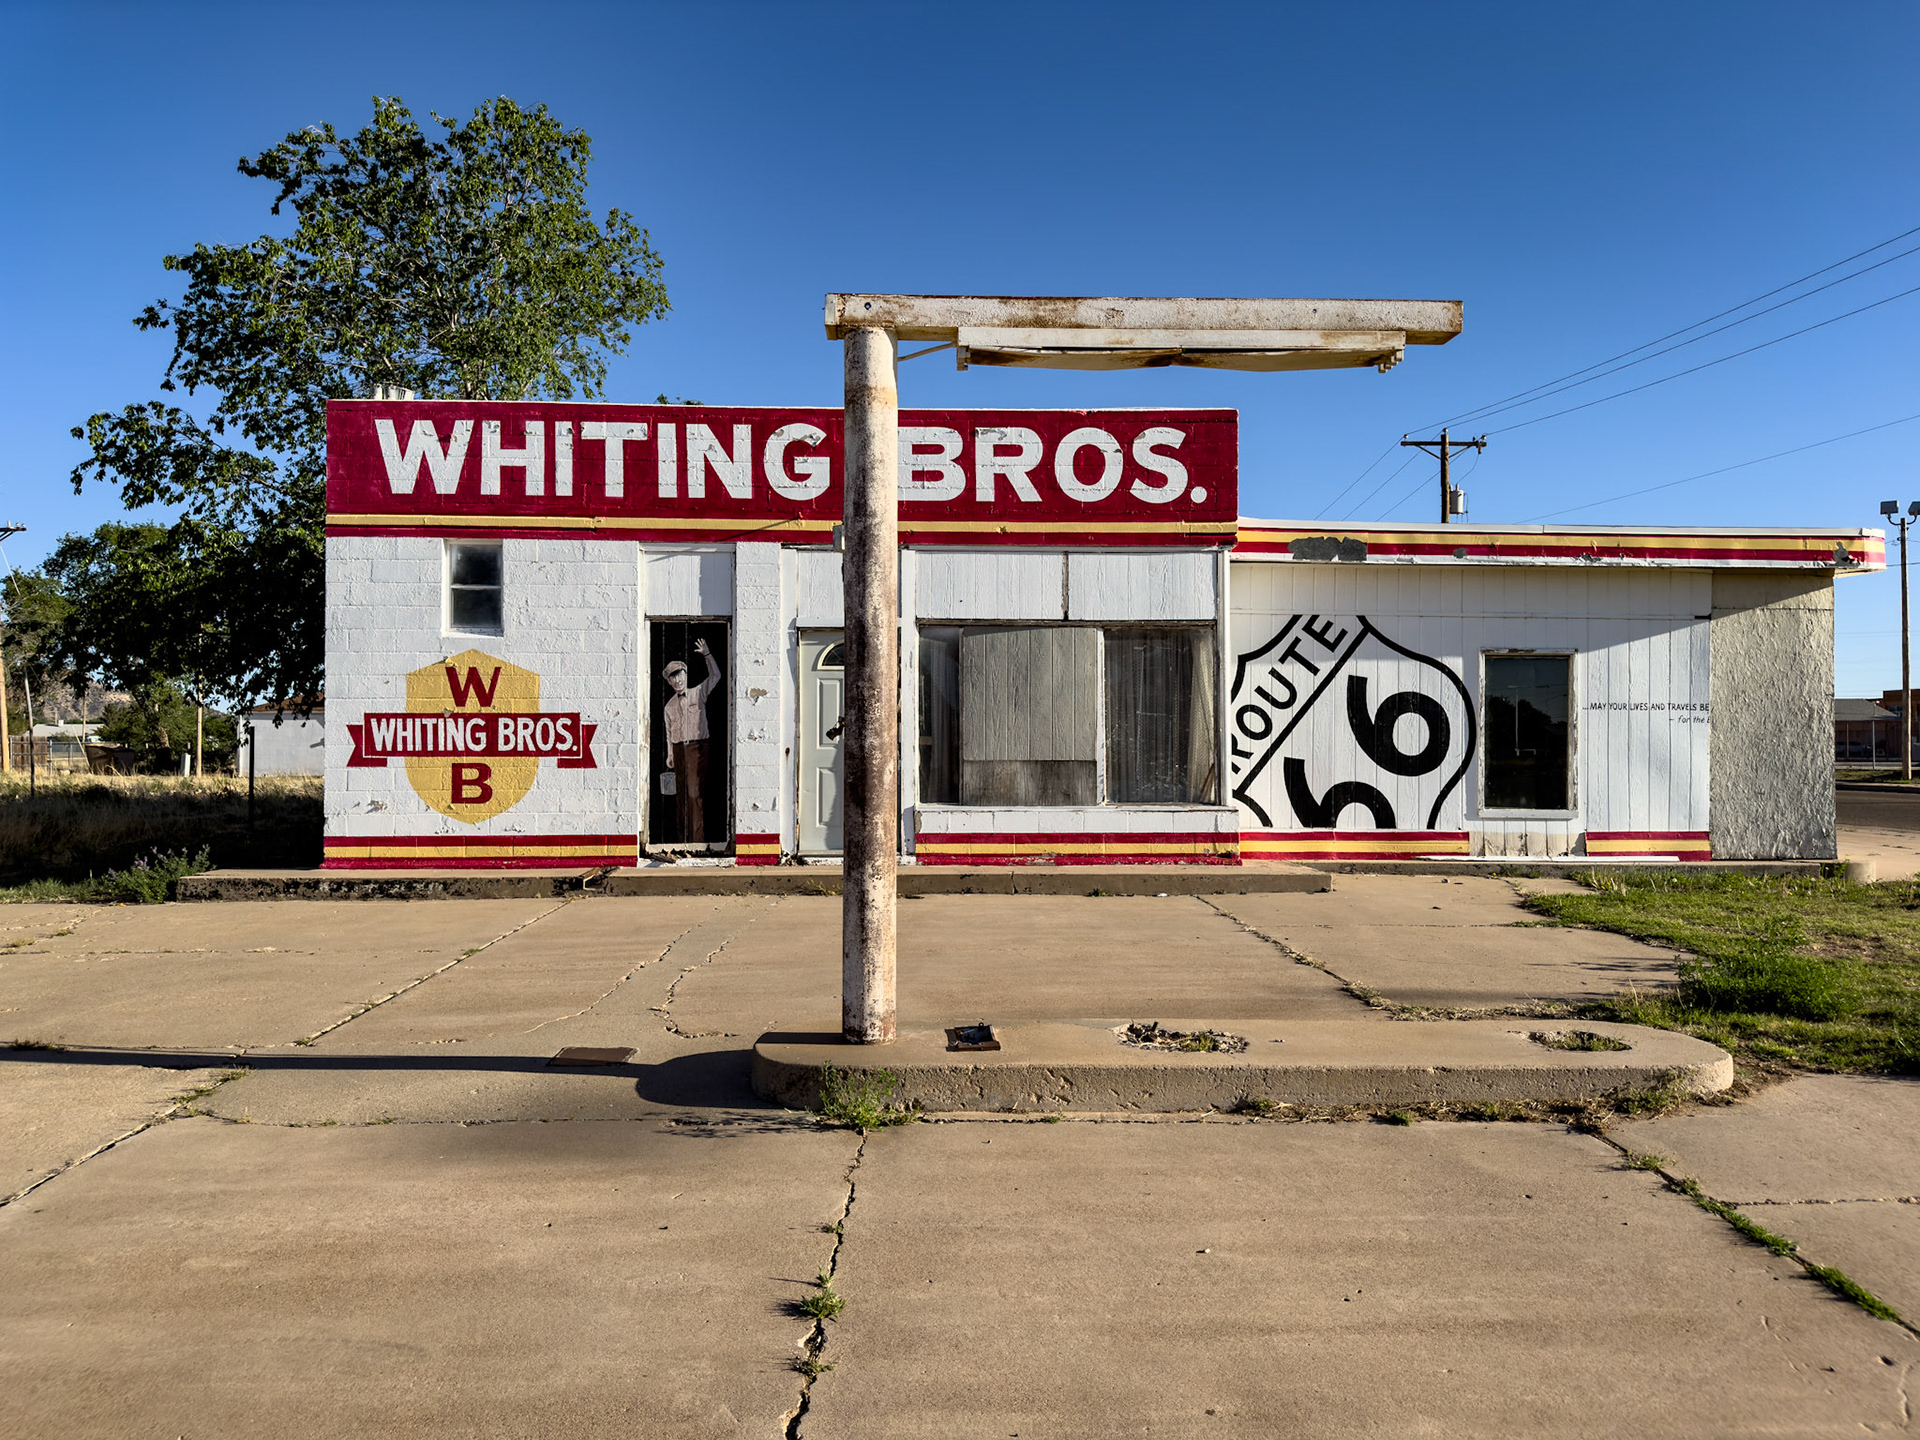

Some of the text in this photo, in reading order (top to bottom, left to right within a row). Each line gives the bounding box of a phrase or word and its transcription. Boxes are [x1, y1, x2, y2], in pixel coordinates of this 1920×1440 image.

[375, 419, 1208, 505] WHITING BROS.
[445, 667, 502, 707] W
[1608, 702, 1628, 711] YOUR
[1629, 702, 1648, 711] LIVES
[1651, 702, 1666, 711] AND
[1667, 702, 1697, 712] TRAVELS
[1677, 714, 1690, 724] for
[1693, 714, 1705, 724] the
[370, 717, 578, 752] WHITING BROS.
[451, 762, 493, 804] B
